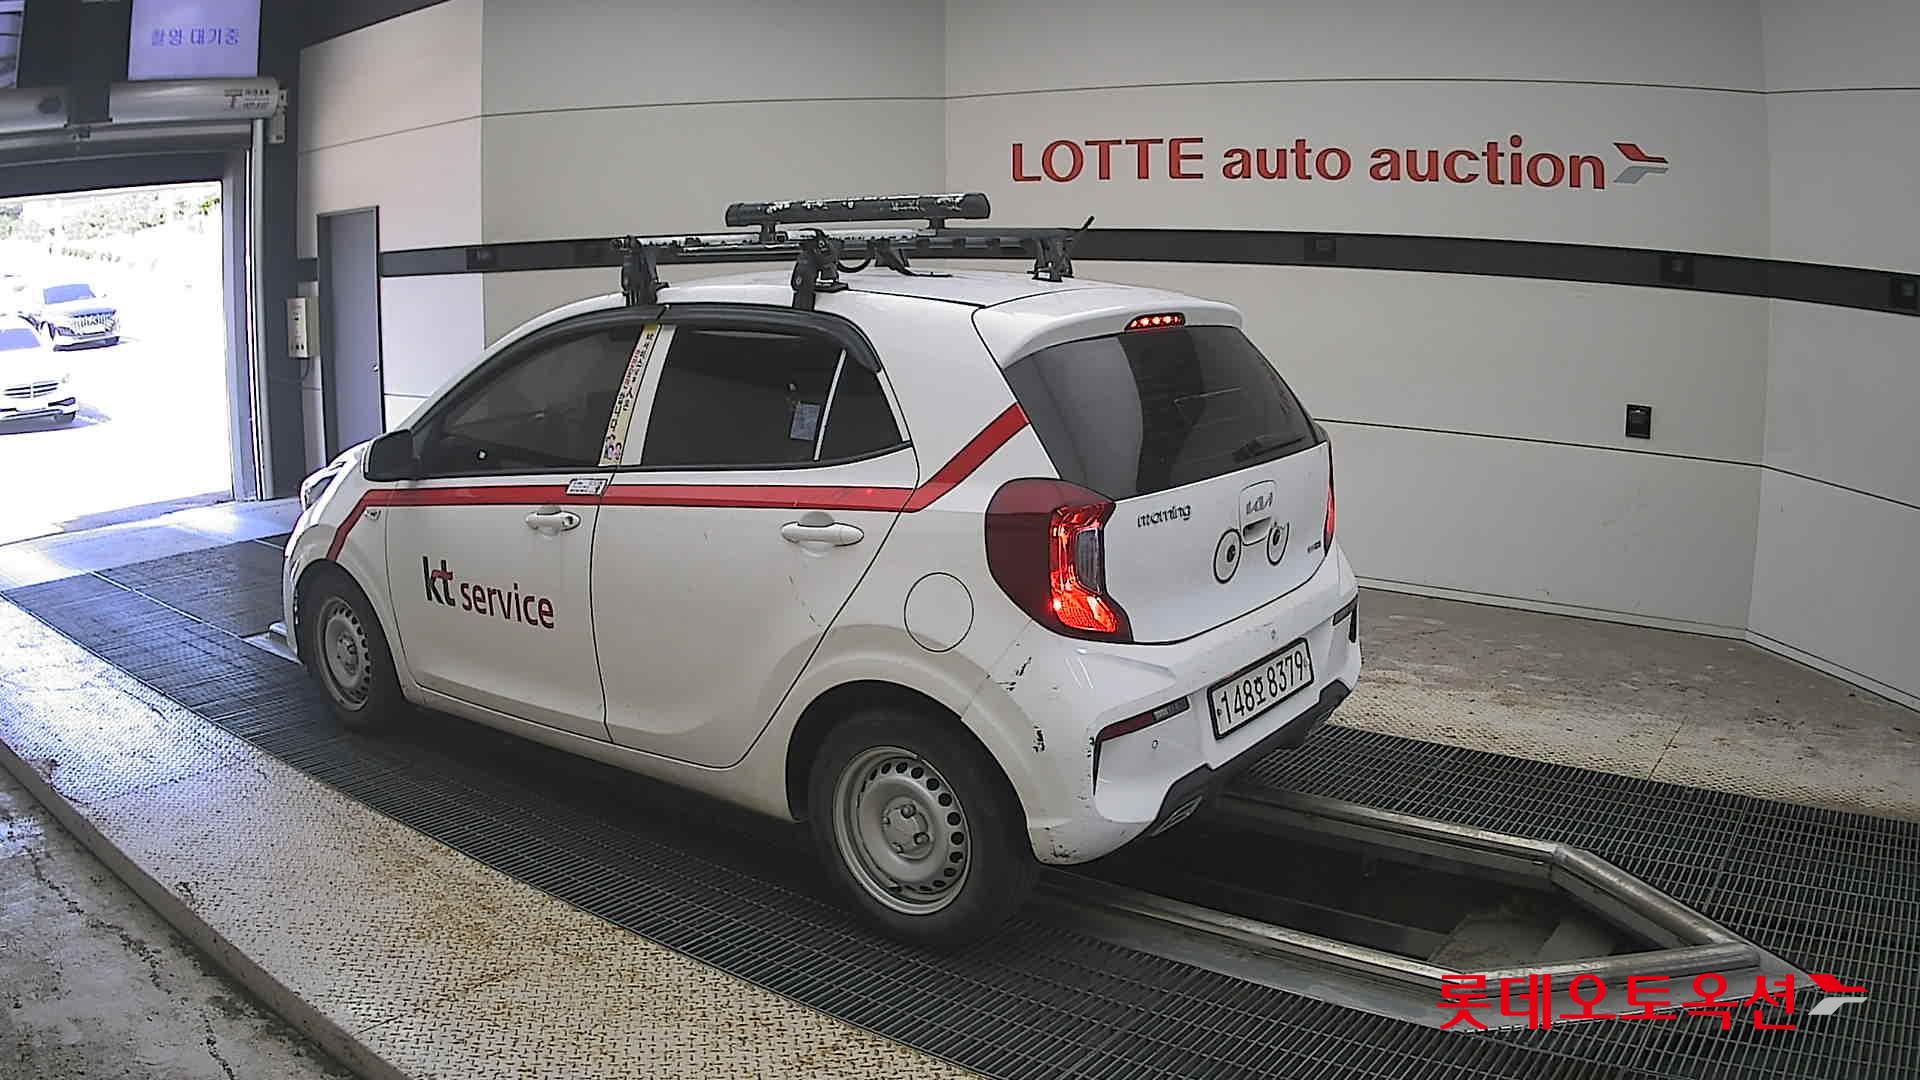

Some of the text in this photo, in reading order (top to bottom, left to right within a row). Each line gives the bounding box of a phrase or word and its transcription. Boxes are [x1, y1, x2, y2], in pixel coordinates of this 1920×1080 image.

[190, 27, 240, 47] 대기중
[1012, 135, 1606, 190] LOTTE auto auction
[422, 555, 555, 629] kt service
[1221, 650, 1303, 724] 148호 8379
